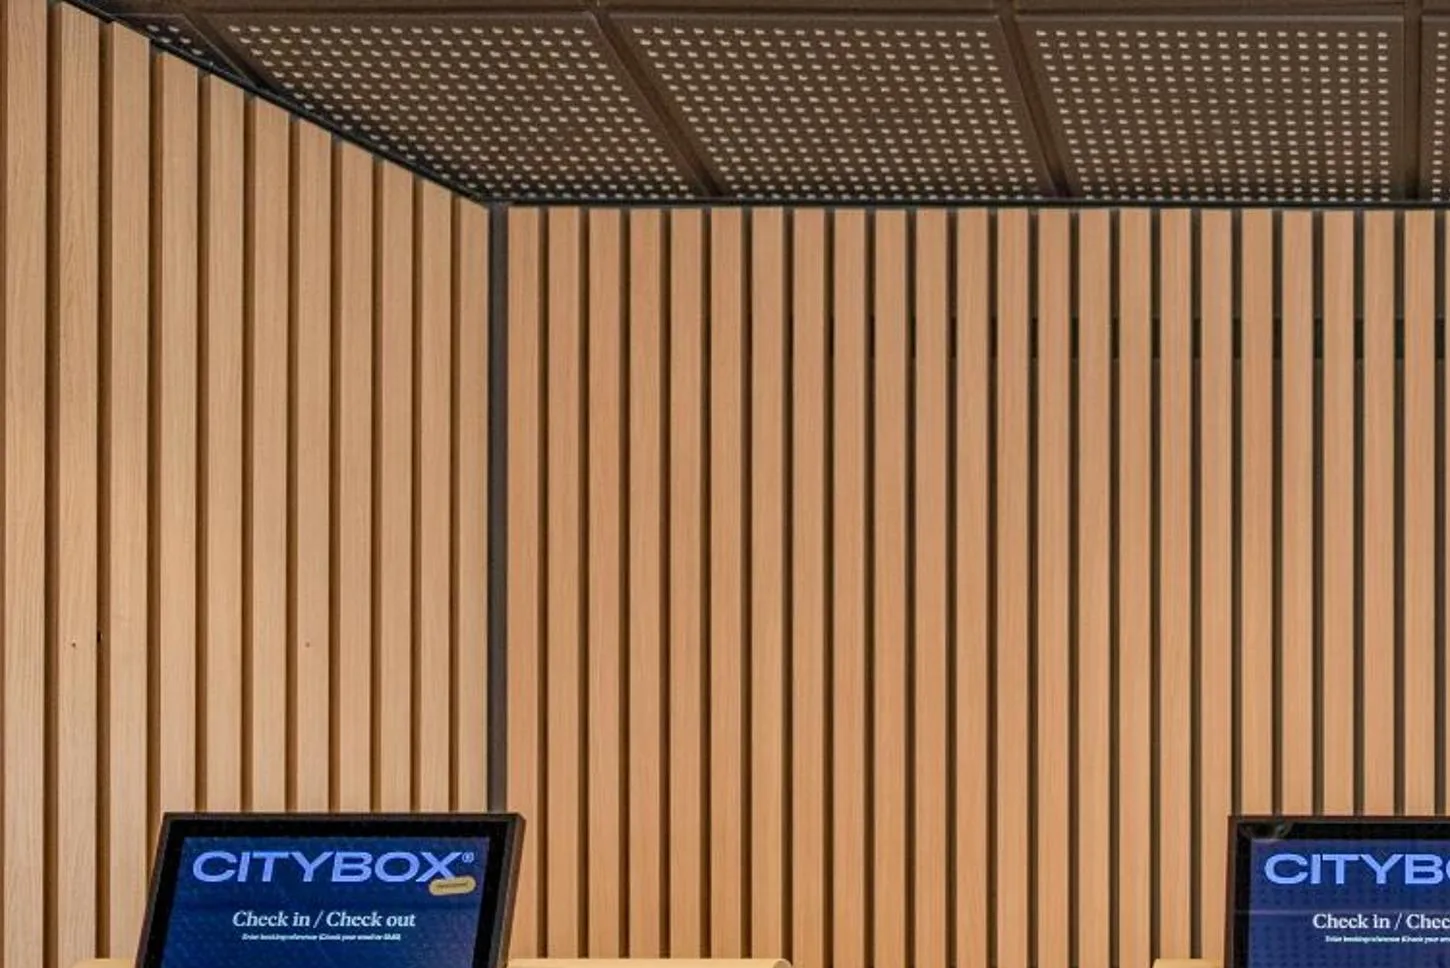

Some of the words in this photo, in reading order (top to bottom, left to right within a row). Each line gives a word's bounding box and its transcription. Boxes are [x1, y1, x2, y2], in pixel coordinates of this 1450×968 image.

[232, 911, 289, 927] Check
[292, 911, 311, 927] in
[326, 911, 383, 927] Check
[386, 912, 416, 927] out
[1312, 914, 1370, 930] Check
[1373, 914, 1390, 930] in
